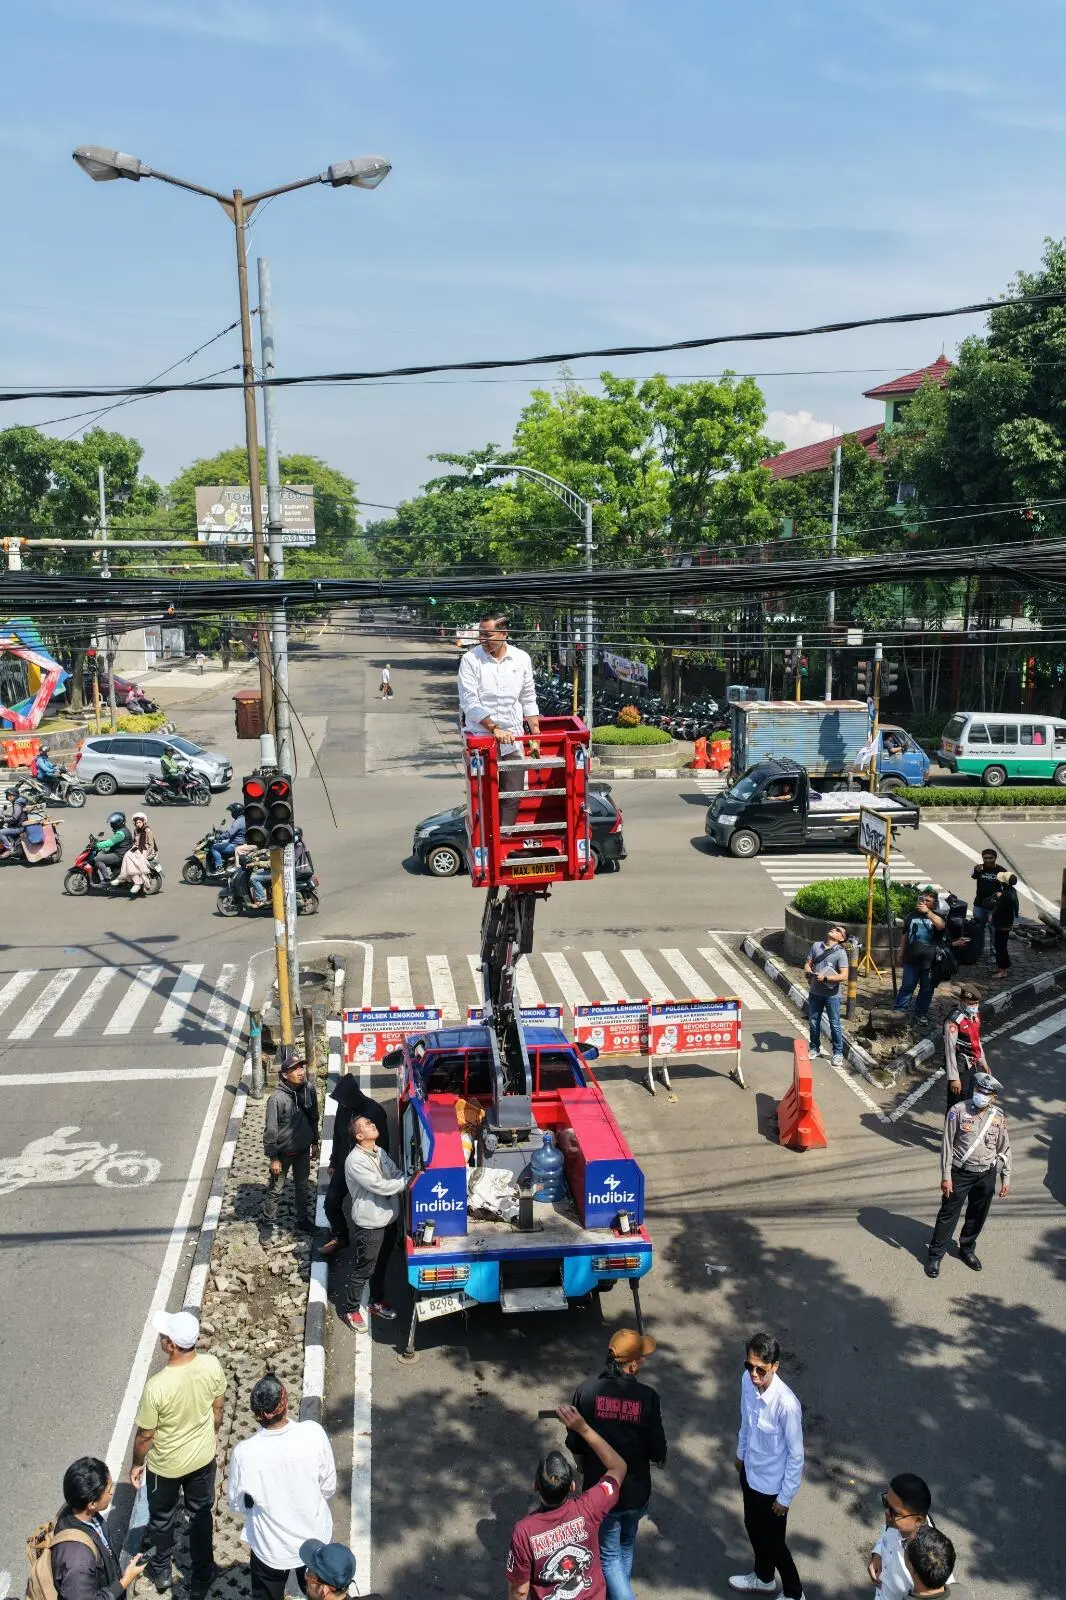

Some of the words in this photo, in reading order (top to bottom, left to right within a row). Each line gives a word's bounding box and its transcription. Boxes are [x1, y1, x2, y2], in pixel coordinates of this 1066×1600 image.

[514, 866, 529, 876] MAX.
[531, 864, 544, 875] 100
[545, 863, 555, 872] KG
[592, 1006, 616, 1014] POLSEK
[690, 1002, 723, 1010] LENGKONG
[389, 1011, 425, 1019] LENGKONG
[610, 1024, 637, 1032] BEYOND
[588, 1191, 636, 1204] indibiz
[415, 1199, 464, 1213] indibiz
[419, 1304, 426, 1315] L
